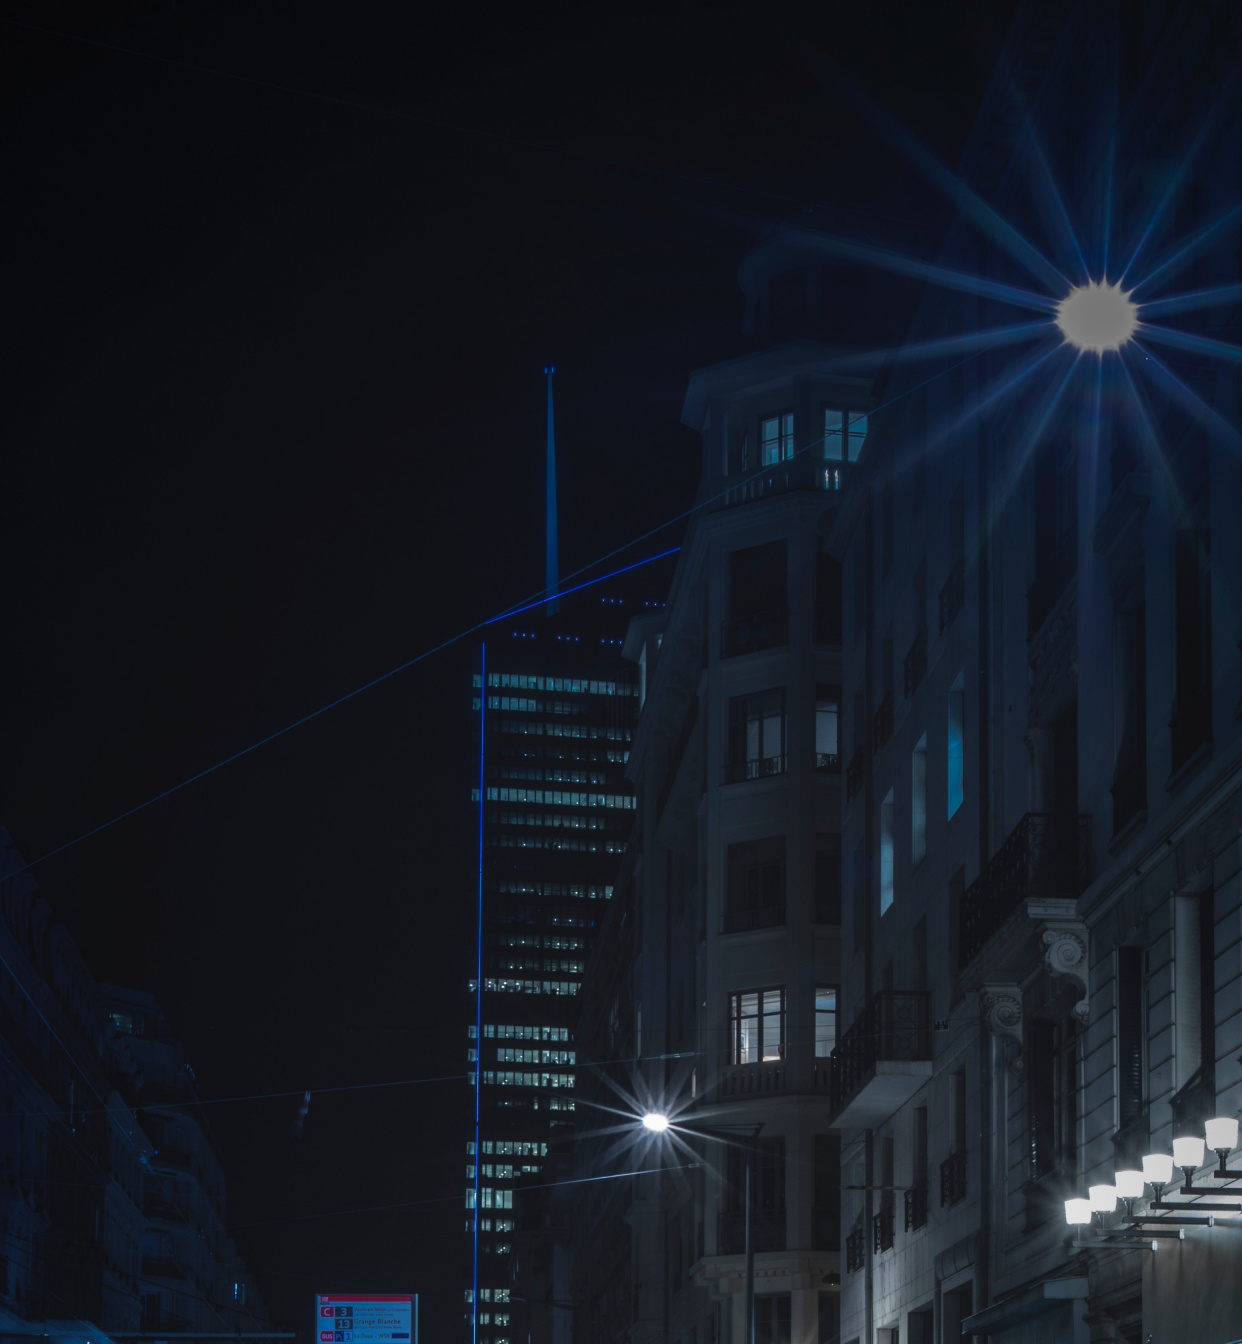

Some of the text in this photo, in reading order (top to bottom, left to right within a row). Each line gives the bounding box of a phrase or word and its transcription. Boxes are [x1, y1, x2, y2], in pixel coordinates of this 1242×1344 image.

[324, 1308, 330, 1316] C
[340, 1308, 347, 1316] 3
[338, 1320, 350, 1328] 13
